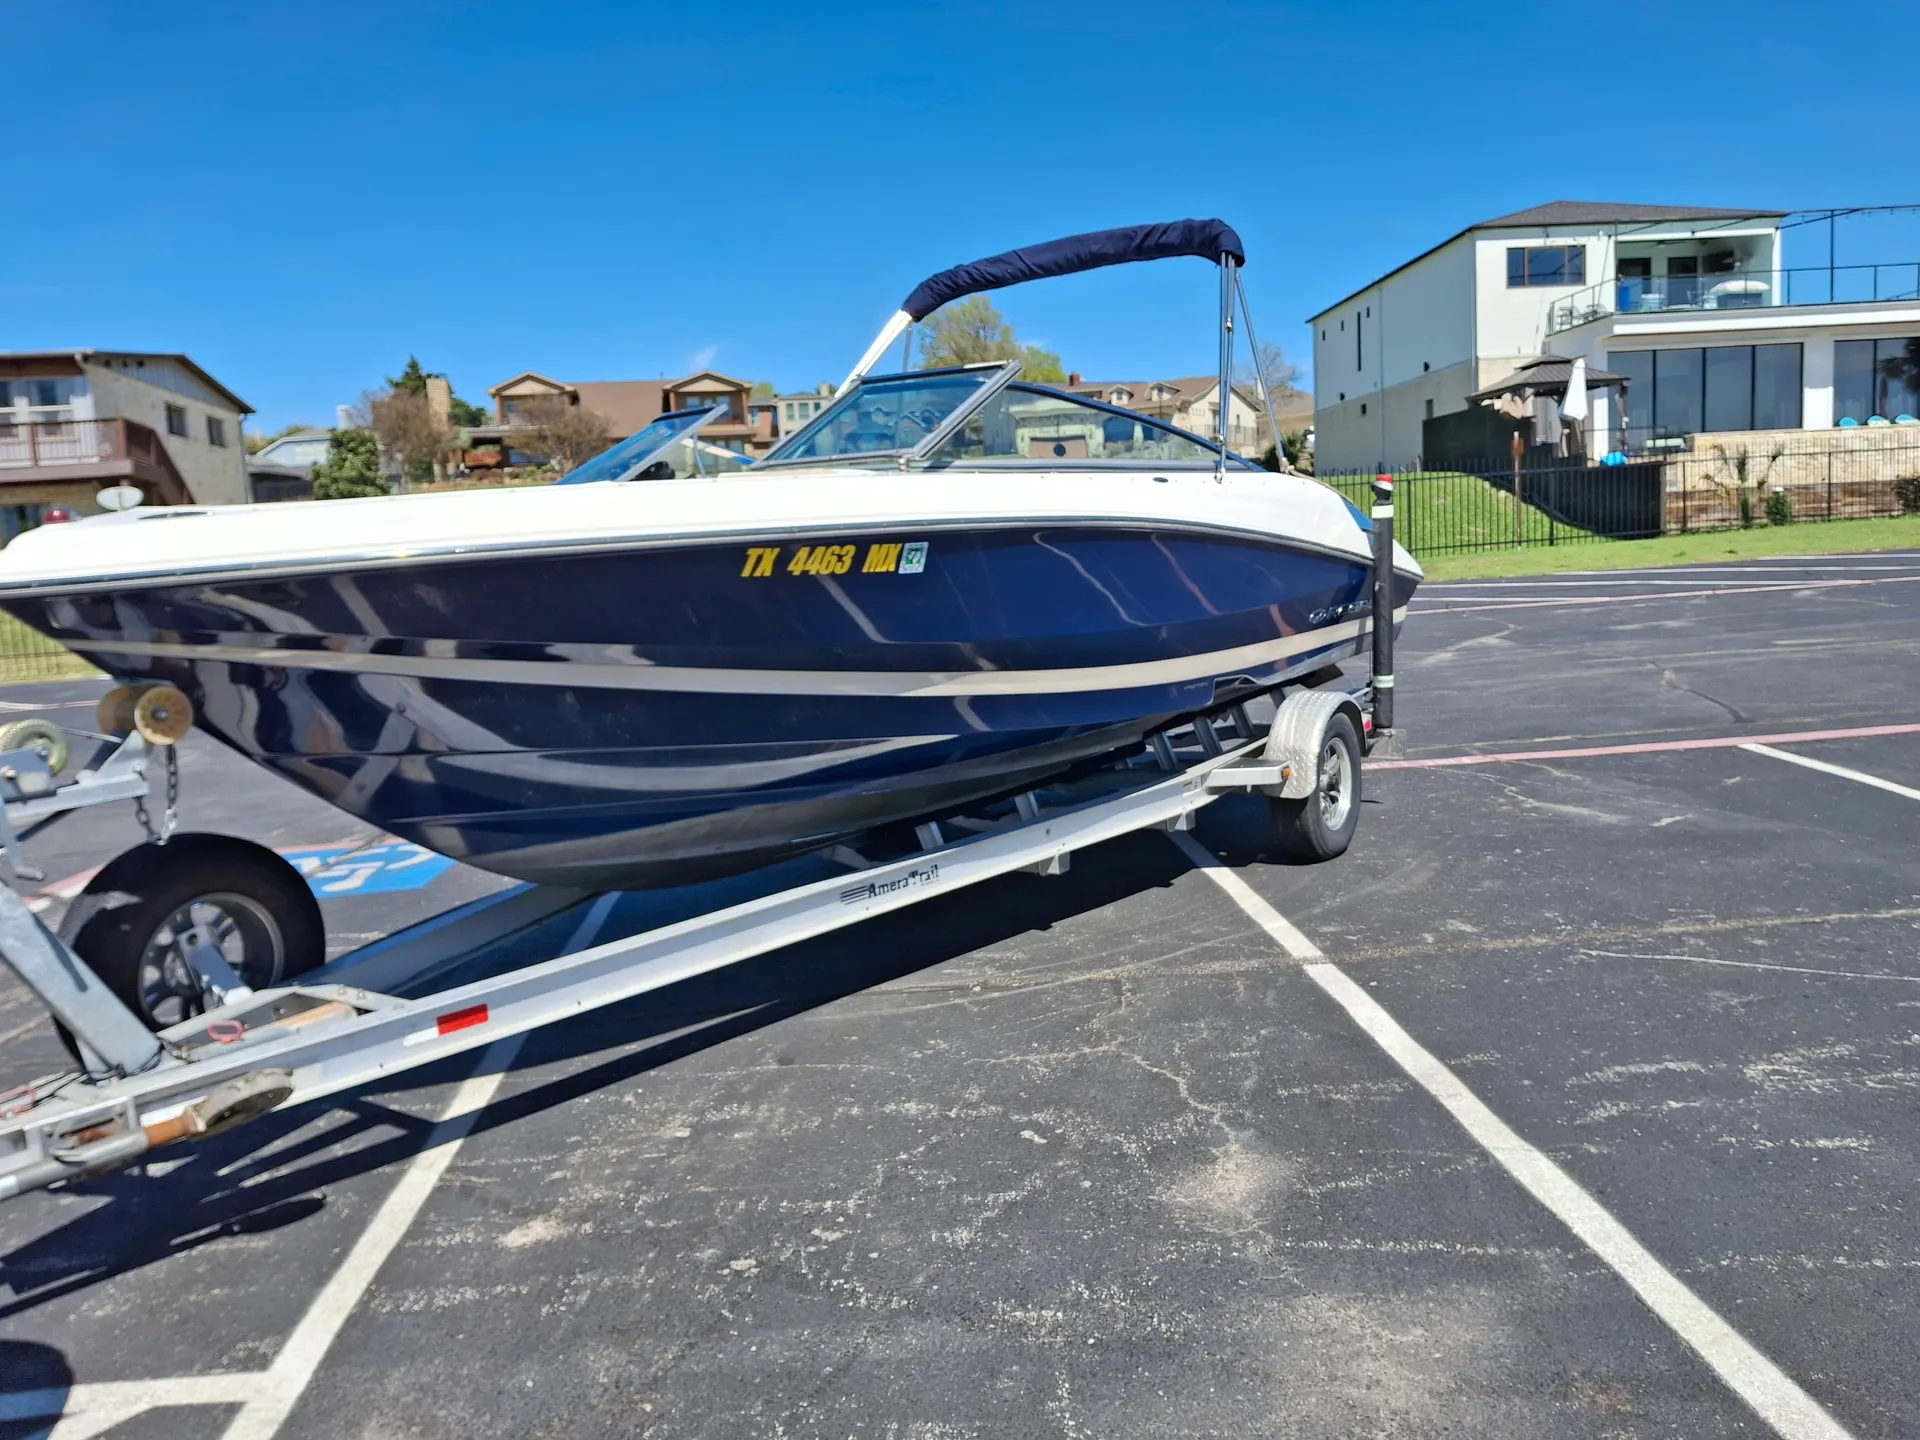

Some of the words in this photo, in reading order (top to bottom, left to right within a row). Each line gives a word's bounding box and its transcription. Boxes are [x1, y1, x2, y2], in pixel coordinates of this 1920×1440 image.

[741, 547, 780, 577] TX
[787, 544, 856, 576] 4463
[861, 543, 903, 573] MX
